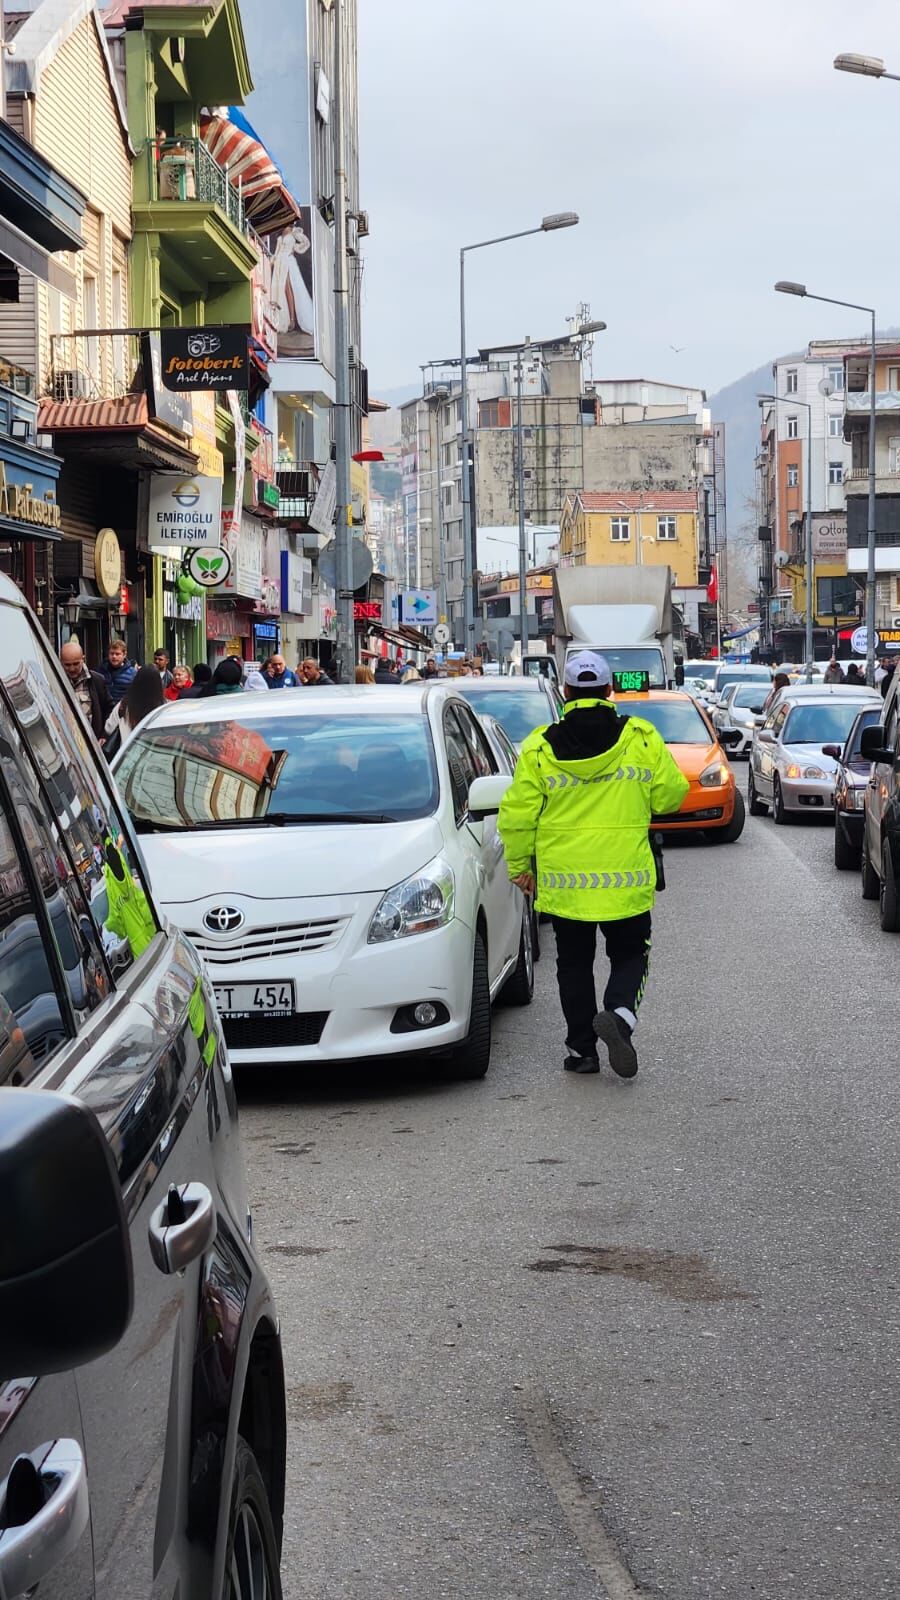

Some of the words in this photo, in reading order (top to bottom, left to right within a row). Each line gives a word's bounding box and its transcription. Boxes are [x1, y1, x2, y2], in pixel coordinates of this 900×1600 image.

[165, 355, 244, 374] fotoberk
[201, 371, 233, 385] Ajans
[156, 510, 213, 523] EMİROĞLU
[160, 526, 207, 541] İLETİŞİM
[621, 681, 642, 690] BOŞ
[214, 988, 235, 1010] ET
[253, 986, 290, 1008] 454
